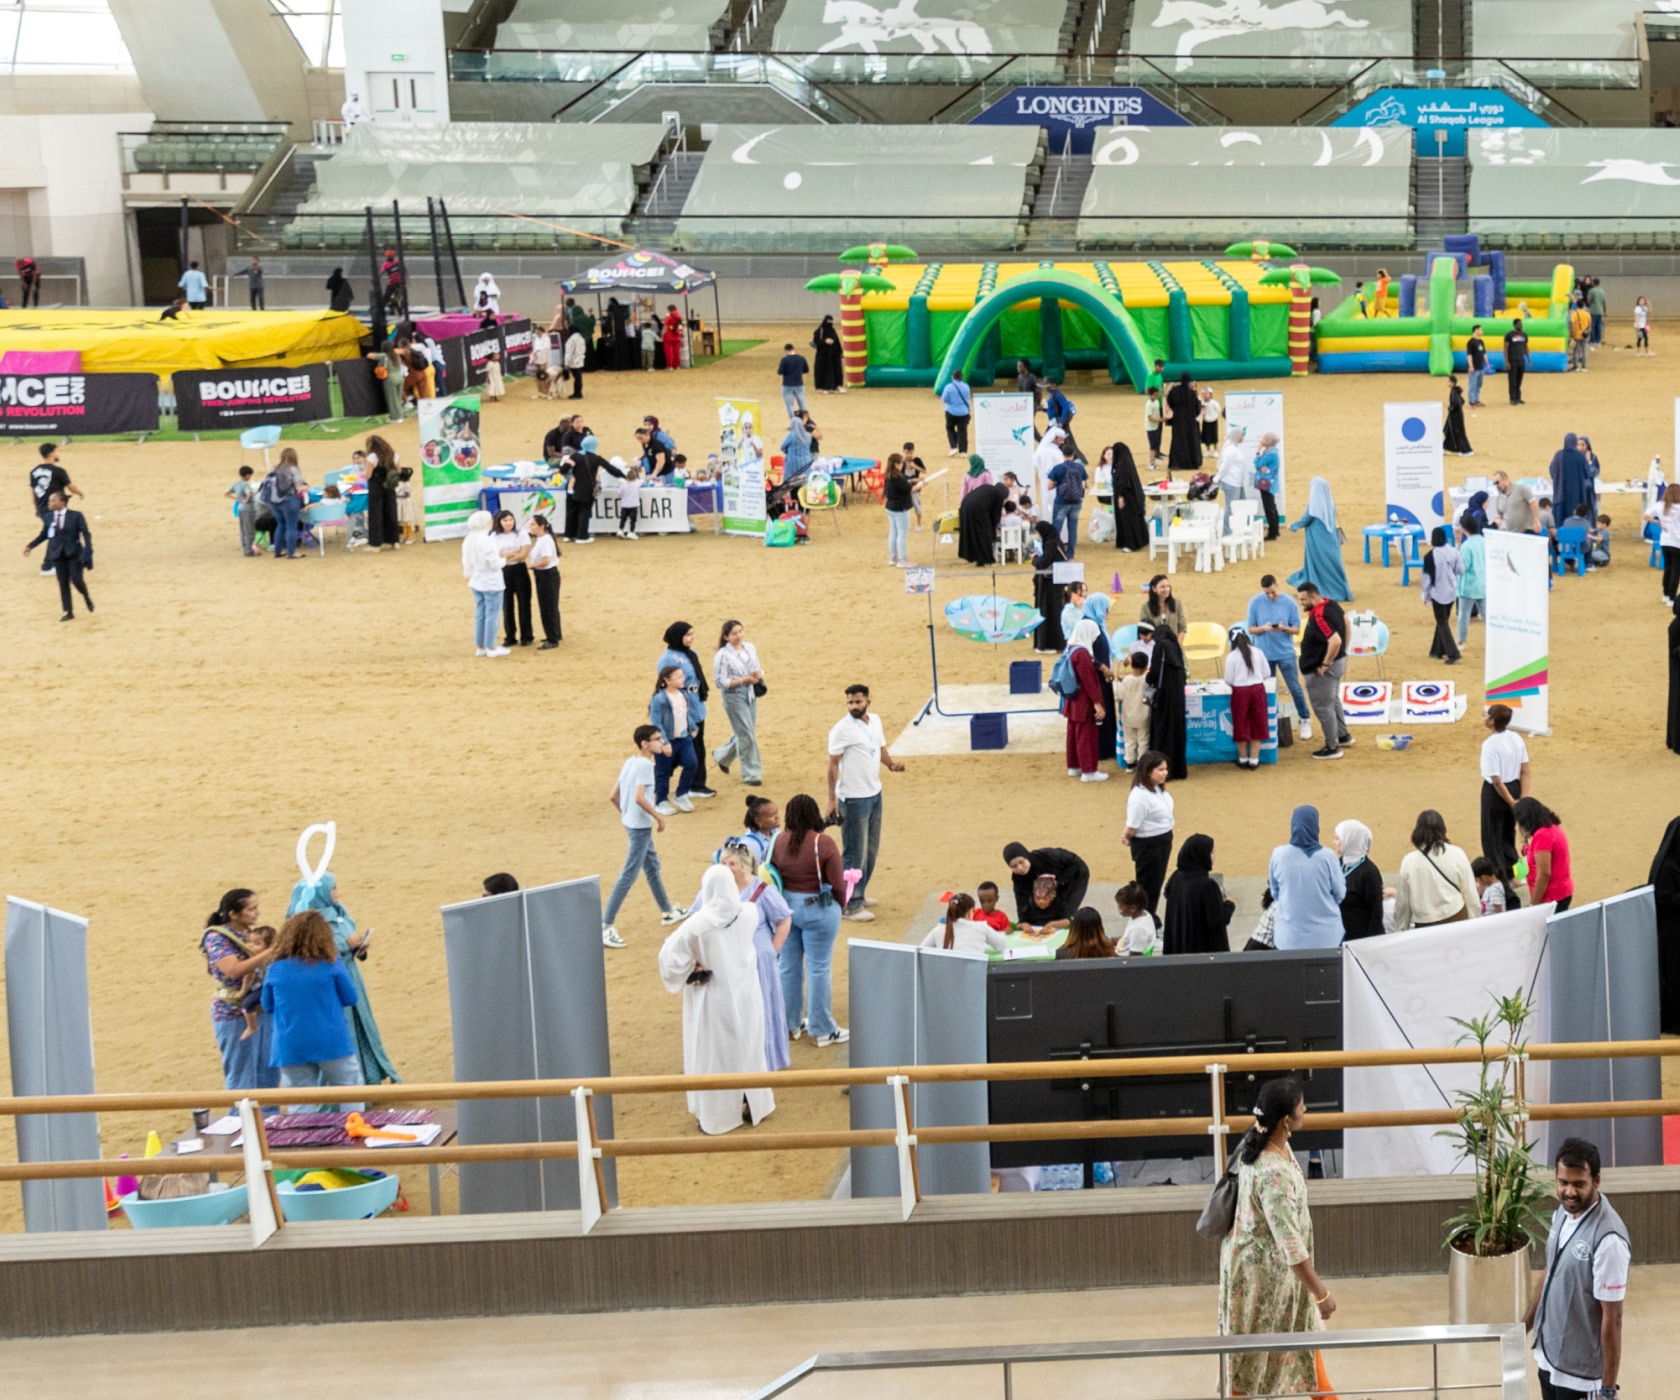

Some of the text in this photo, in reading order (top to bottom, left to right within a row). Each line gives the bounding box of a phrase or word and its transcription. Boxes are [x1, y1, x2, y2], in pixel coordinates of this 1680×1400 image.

[1016, 96, 1143, 115] LONGINES
[1417, 115, 1505, 126] Al Shaqab League
[587, 268, 659, 279] BOUNCE
[70, 376, 85, 404] INC
[199, 376, 303, 401] BOUNCE
[263, 393, 311, 404] REVOLUTION
[6, 405, 85, 417] REVOLUTION
